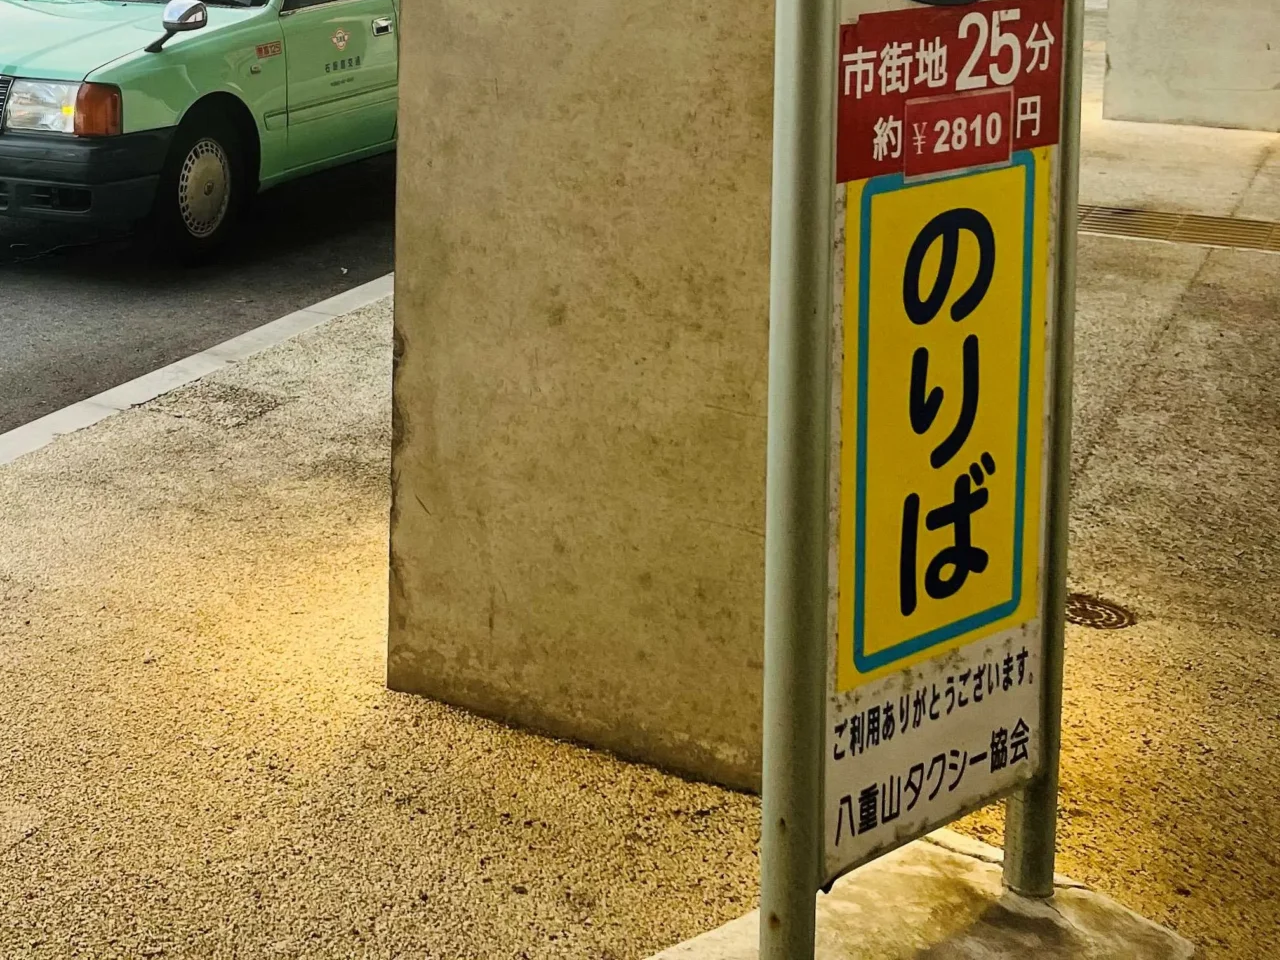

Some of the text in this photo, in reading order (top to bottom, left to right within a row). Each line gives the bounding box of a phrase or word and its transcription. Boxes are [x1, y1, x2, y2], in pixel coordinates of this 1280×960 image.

[842, 8, 1056, 100] 市街地25分
[898, 206, 997, 617] のりば
[833, 645, 1034, 761] ご利用ありがとうございます。
[834, 717, 1030, 847] 八重山タクシー協会
